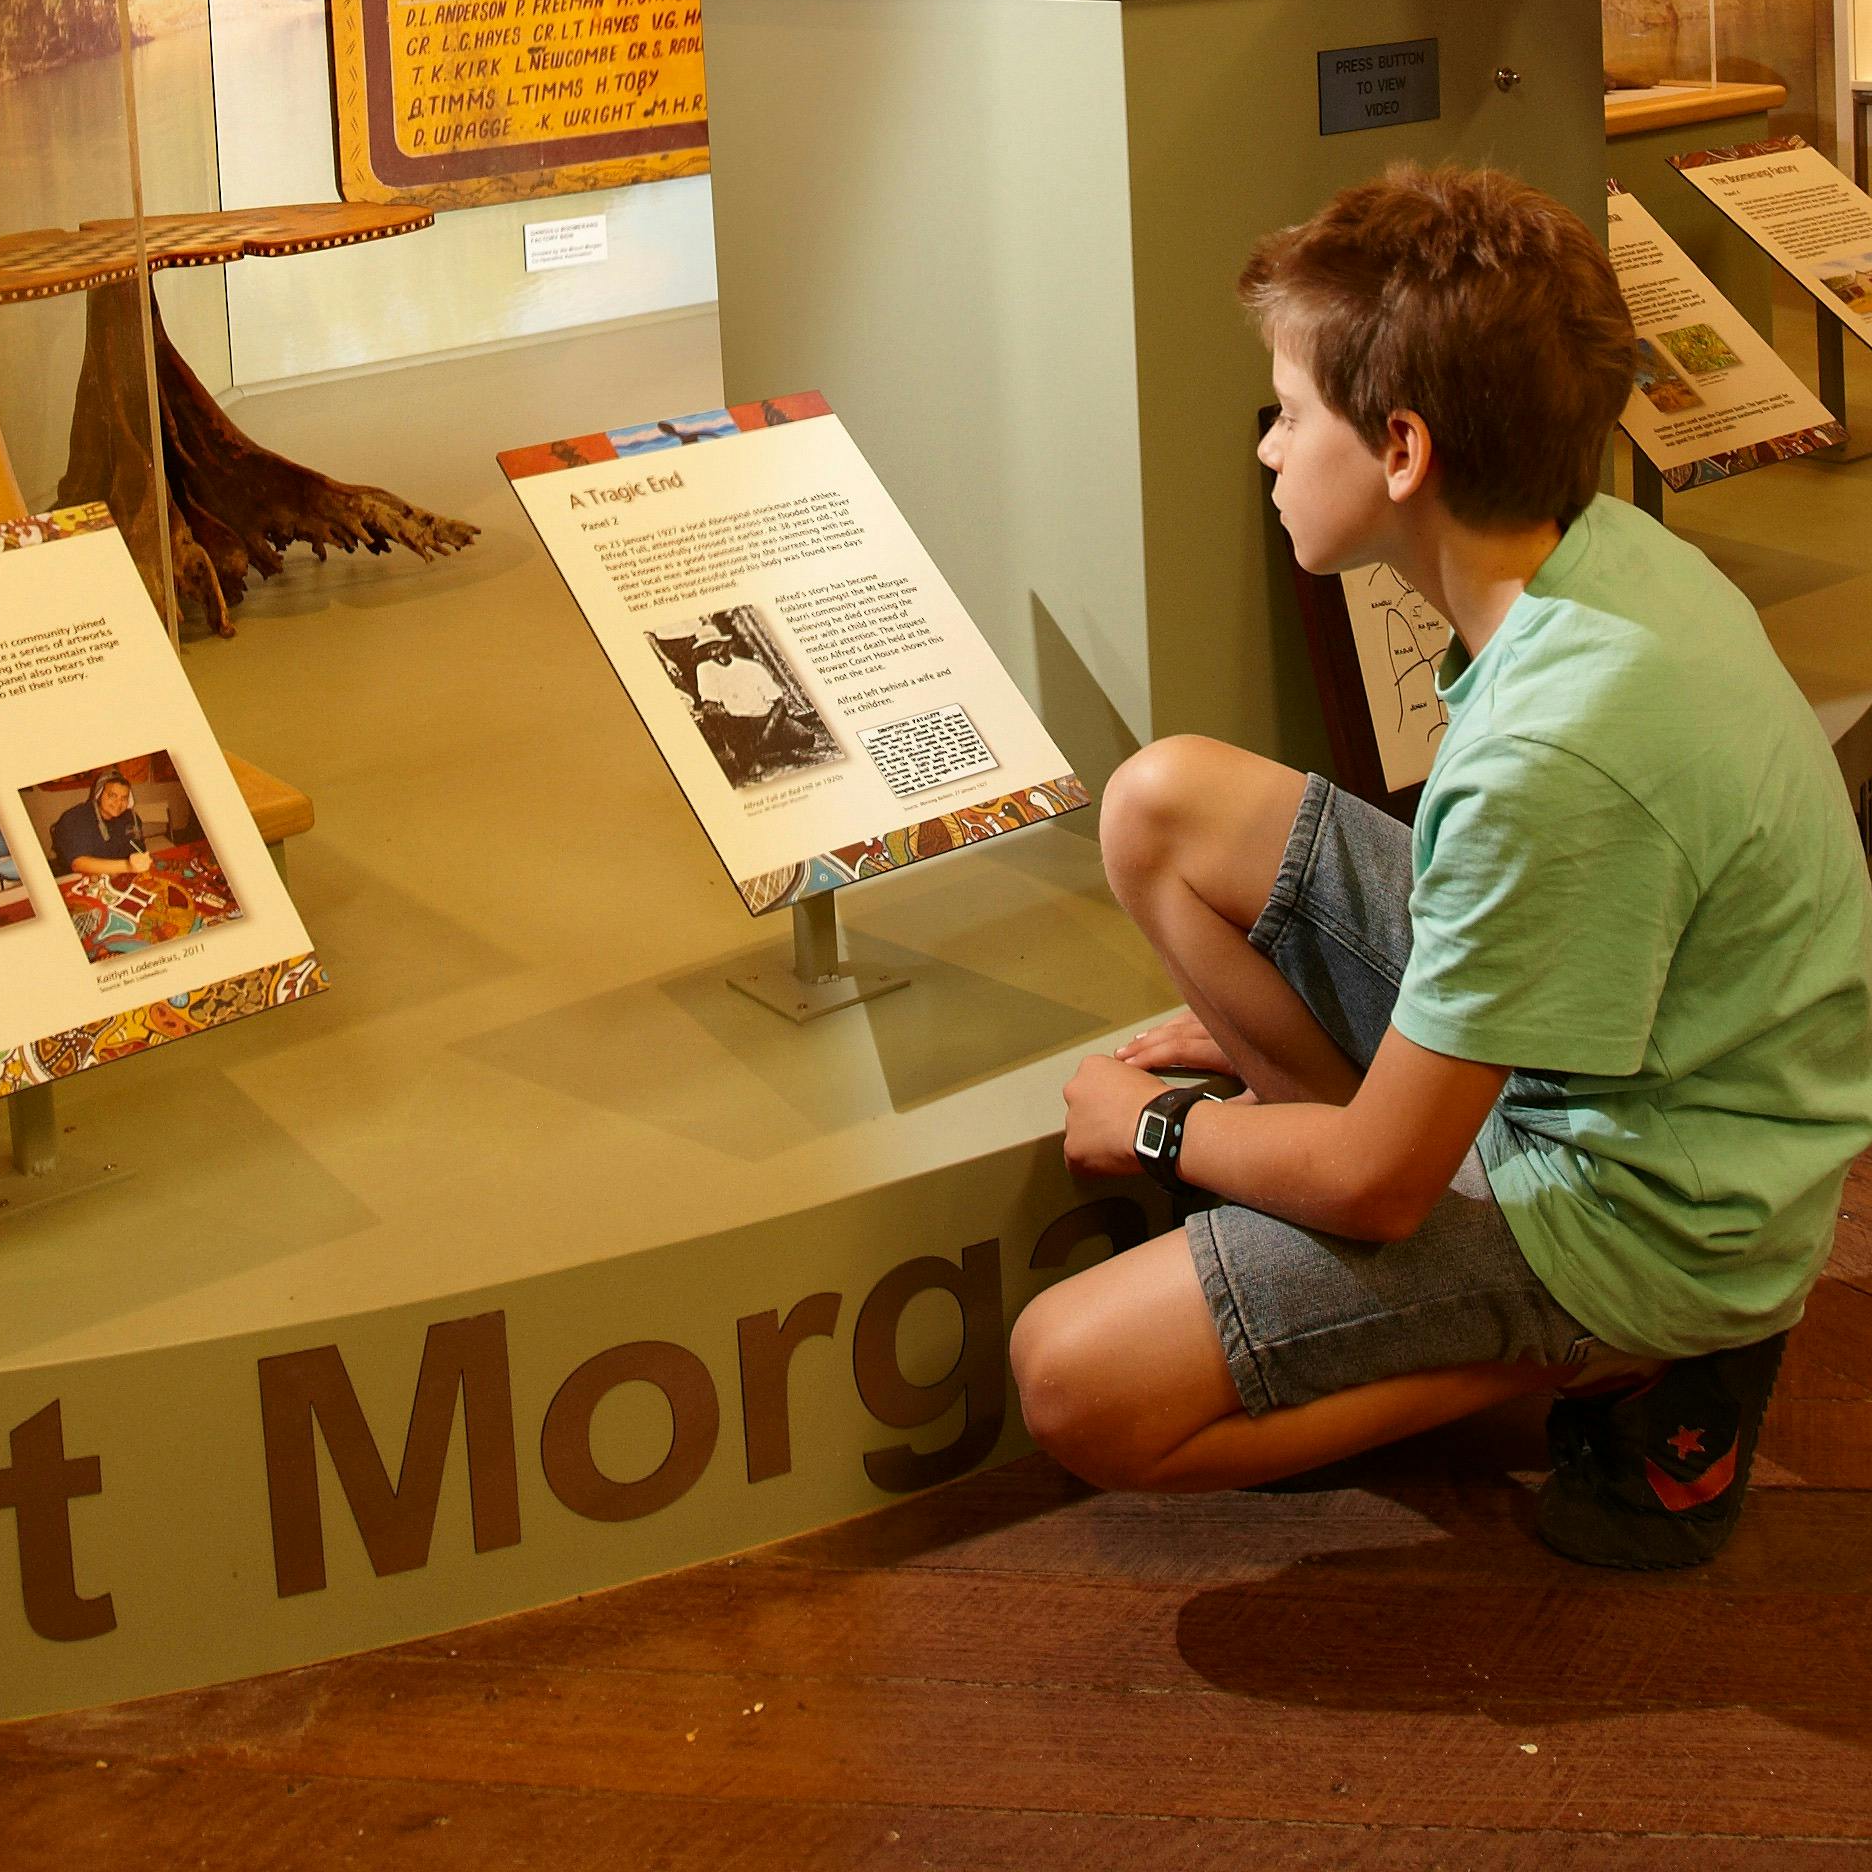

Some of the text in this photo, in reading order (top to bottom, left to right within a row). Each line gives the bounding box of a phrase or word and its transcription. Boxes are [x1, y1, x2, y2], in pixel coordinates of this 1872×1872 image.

[1336, 51, 1424, 74] PRESS BUTTON
[1356, 76, 1406, 95] TO VIEW
[1365, 101, 1399, 117] VIDEO
[570, 471, 684, 510] A Tragic End
[581, 517, 619, 532] Panel 2
[11, 625, 71, 647] community
[72, 617, 106, 637] joined
[838, 693, 863, 704] Alfred
[863, 688, 879, 698] left
[879, 680, 908, 693] behind
[917, 673, 935, 683] wife
[936, 667, 951, 677] and
[858, 698, 894, 712] children.
